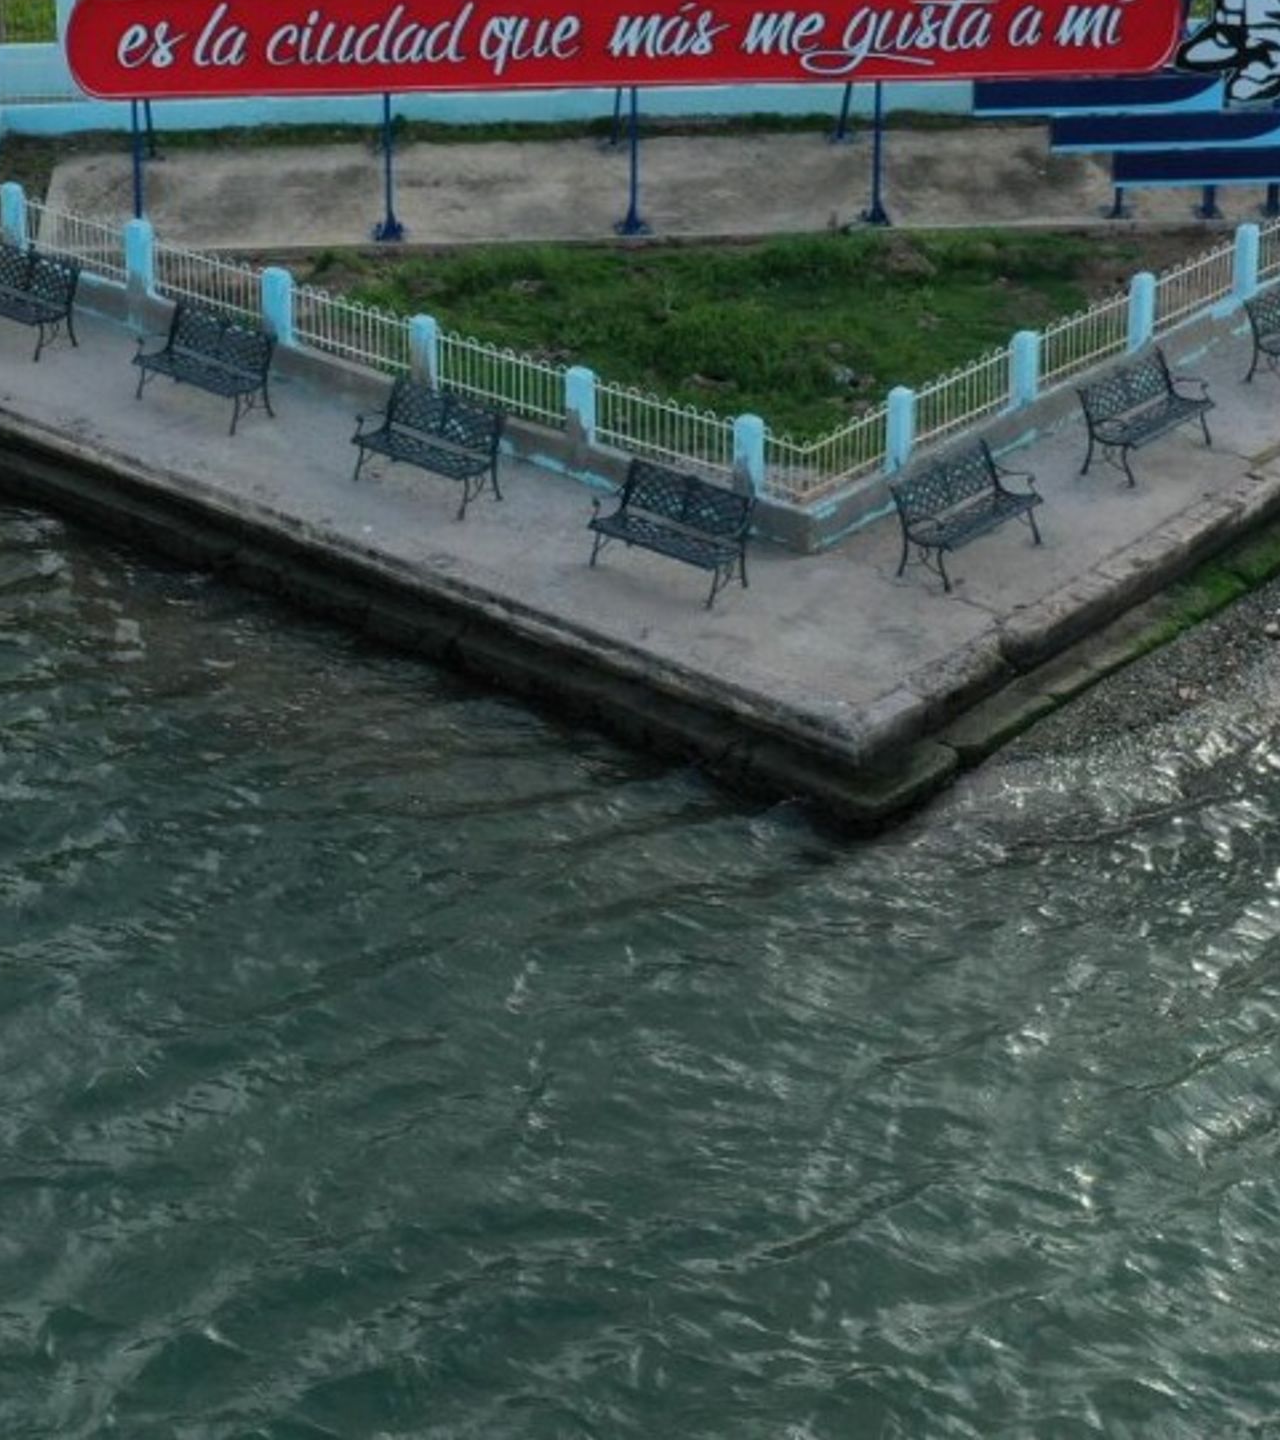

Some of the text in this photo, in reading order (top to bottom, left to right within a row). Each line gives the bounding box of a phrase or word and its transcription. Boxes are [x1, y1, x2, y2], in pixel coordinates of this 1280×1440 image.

[117, 20, 186, 68] es
[193, 2, 248, 67] la
[266, 2, 474, 66] ciudad
[479, 14, 581, 77] que
[608, 3, 730, 58] más
[740, 10, 826, 56] me
[1007, 5, 1043, 48] a
